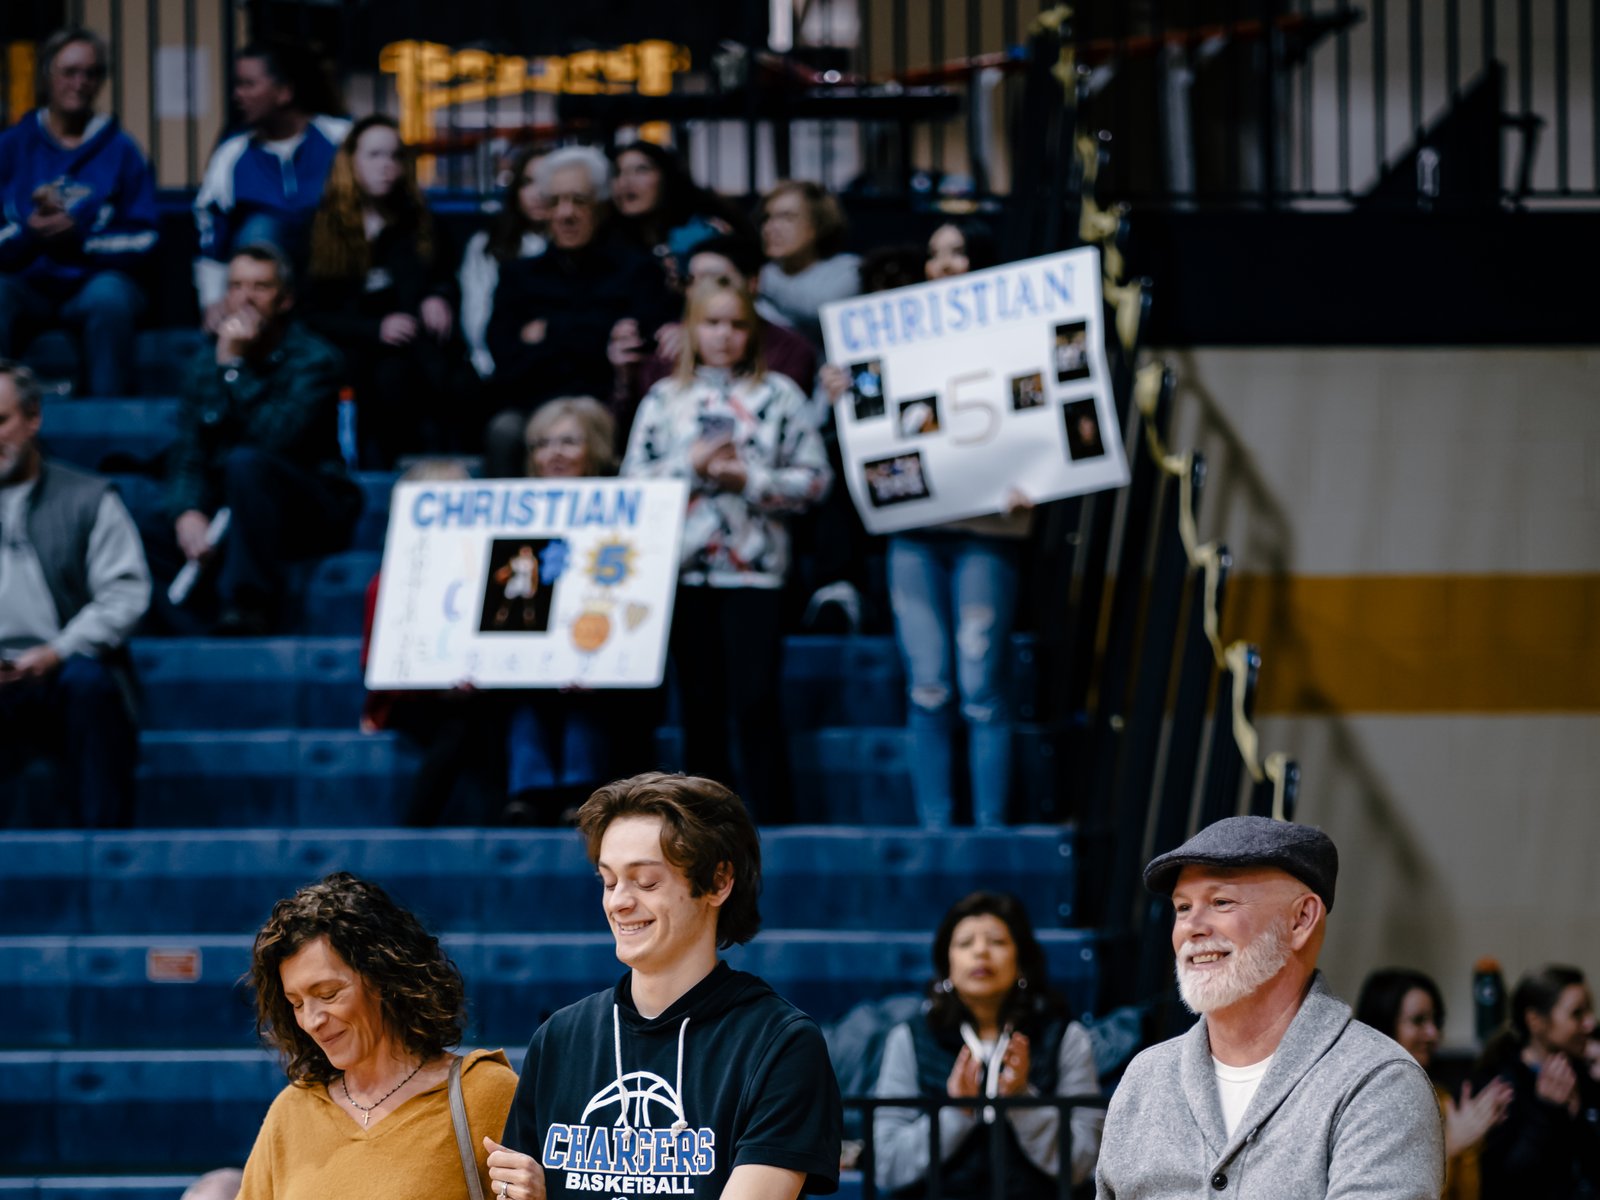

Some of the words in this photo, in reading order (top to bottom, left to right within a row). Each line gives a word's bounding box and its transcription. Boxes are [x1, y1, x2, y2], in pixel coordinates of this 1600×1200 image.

[839, 262, 1078, 353] CHRISTIAN
[947, 369, 1002, 447] 5
[411, 487, 643, 528] CHRISTIAN
[592, 544, 631, 586] 5
[542, 1123, 716, 1175] CHARGERS
[565, 1172, 696, 1194] BASKETBALL
